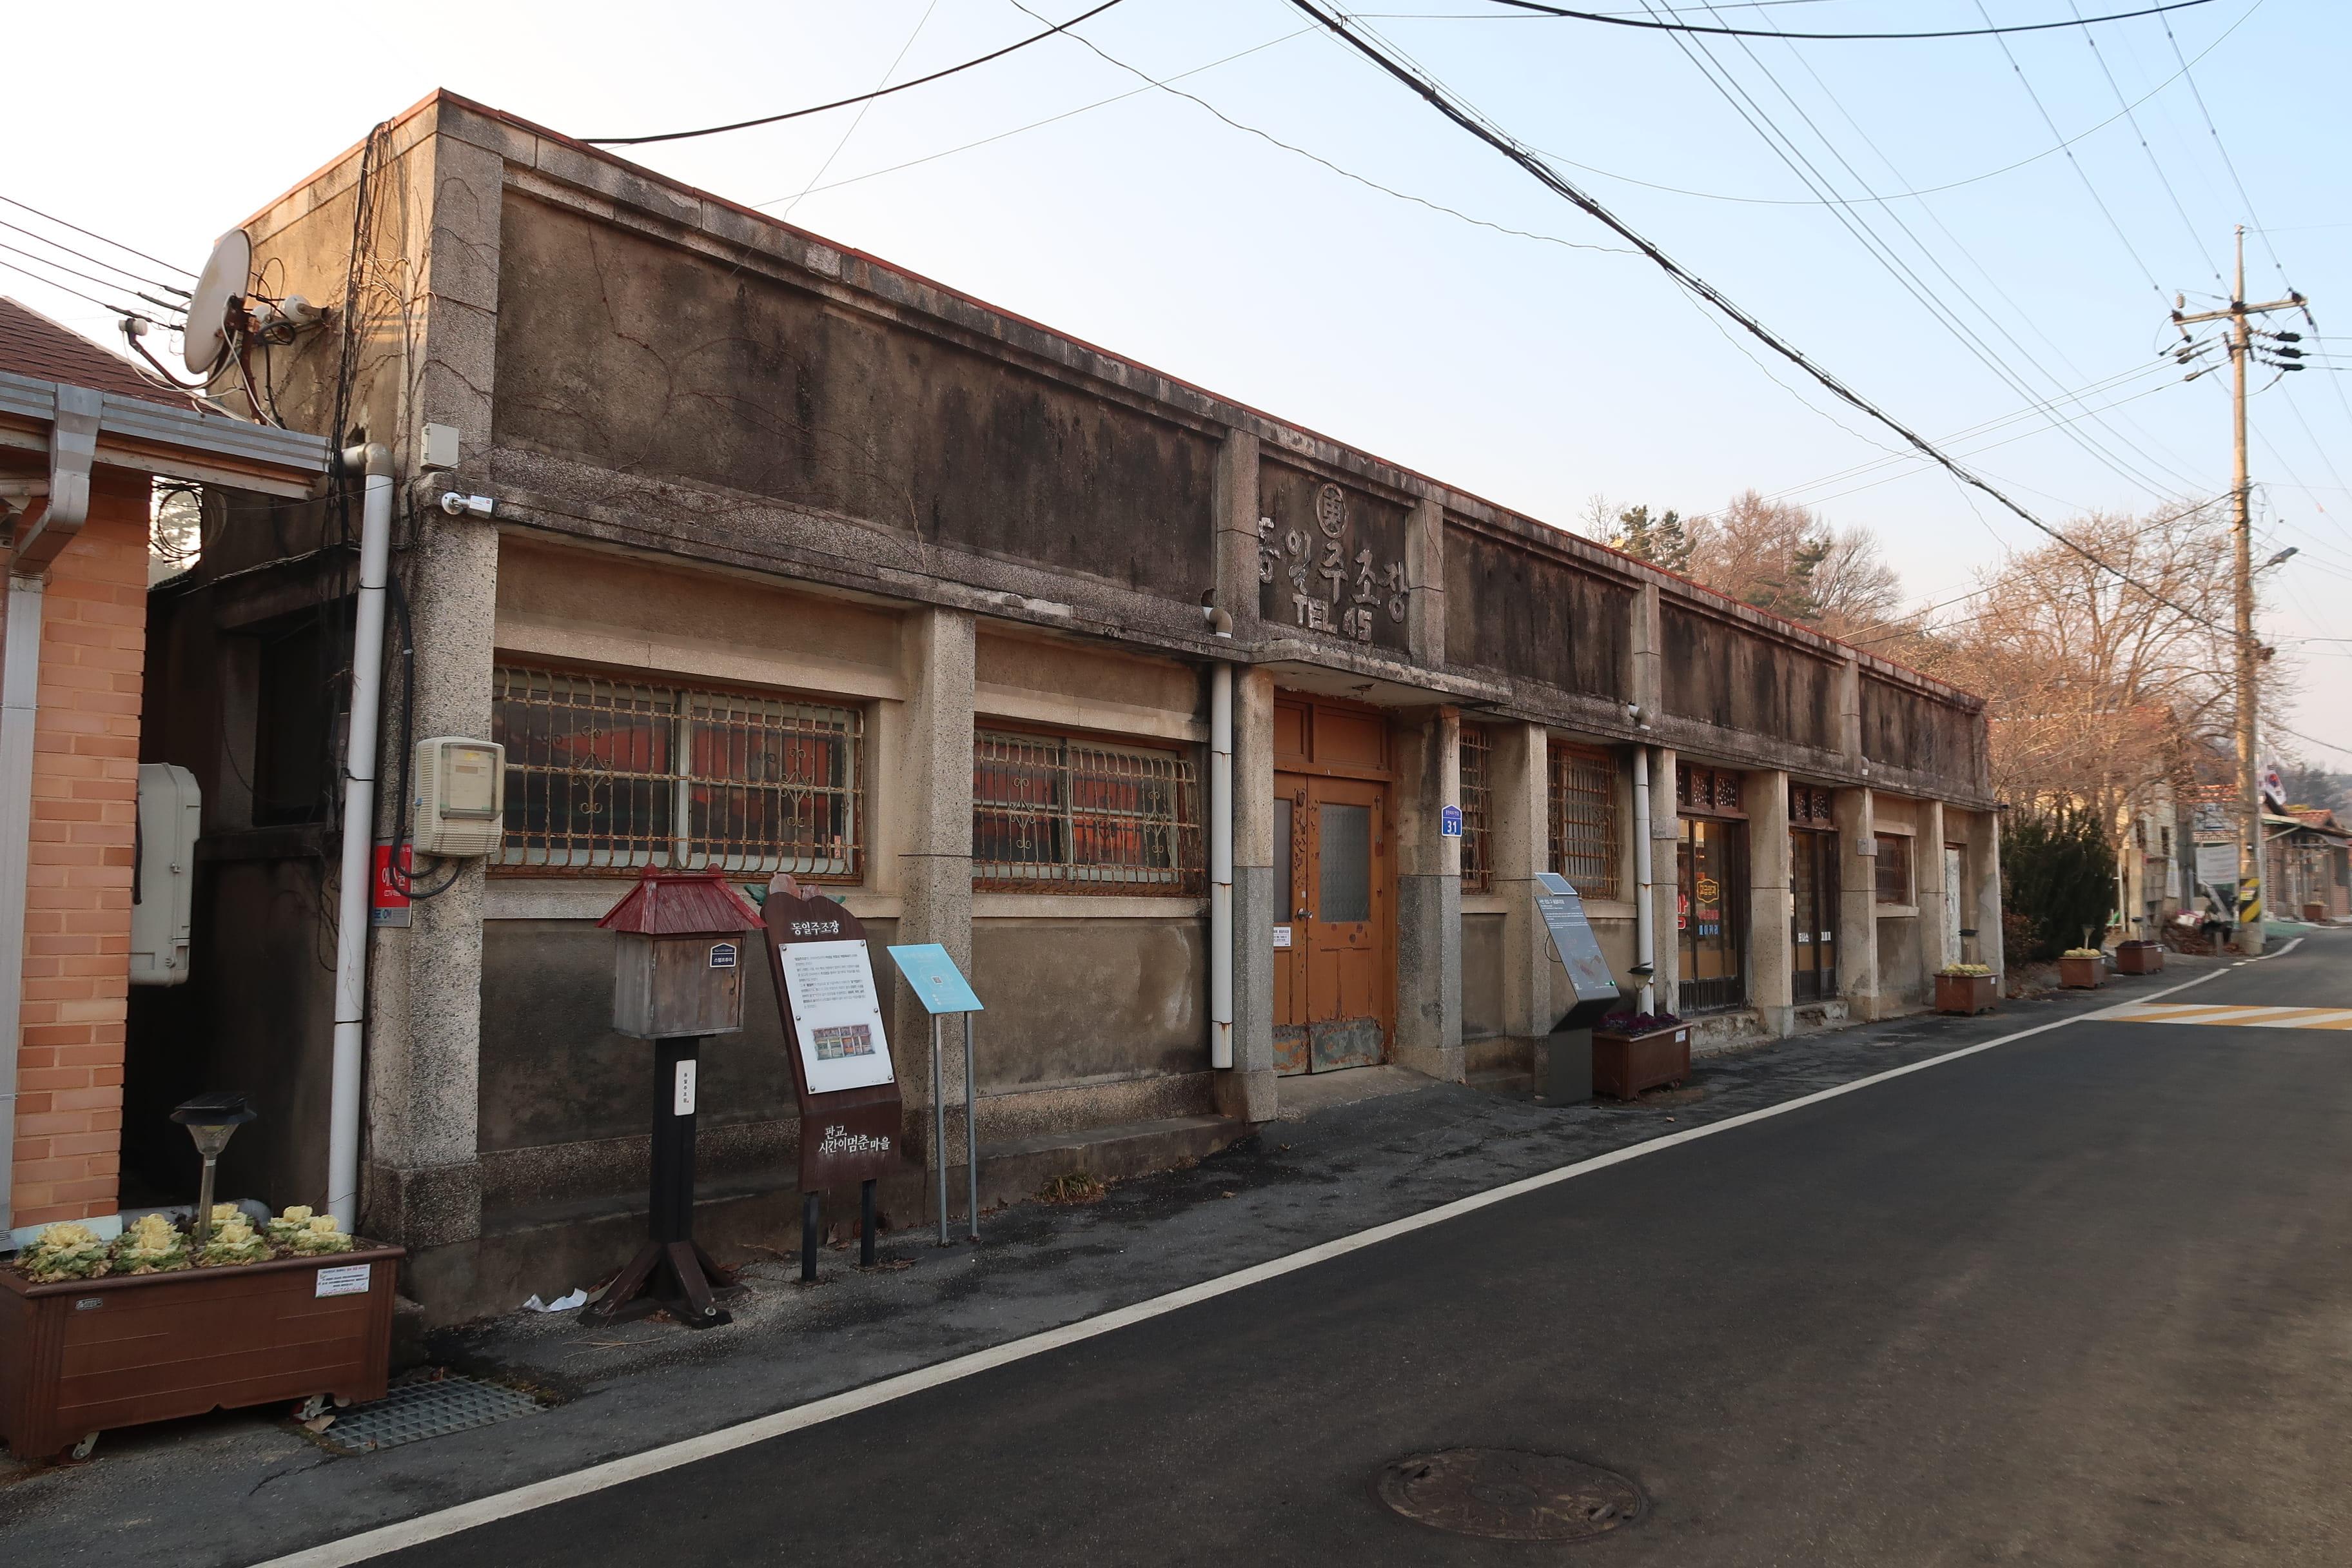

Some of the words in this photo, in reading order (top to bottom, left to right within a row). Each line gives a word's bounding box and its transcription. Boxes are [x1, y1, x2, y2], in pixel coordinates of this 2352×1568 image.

[1293, 593, 1337, 634] TEL
[1447, 821, 1456, 832] 31
[792, 921, 839, 935] 동일주조장
[825, 1125, 847, 1139] 판교,
